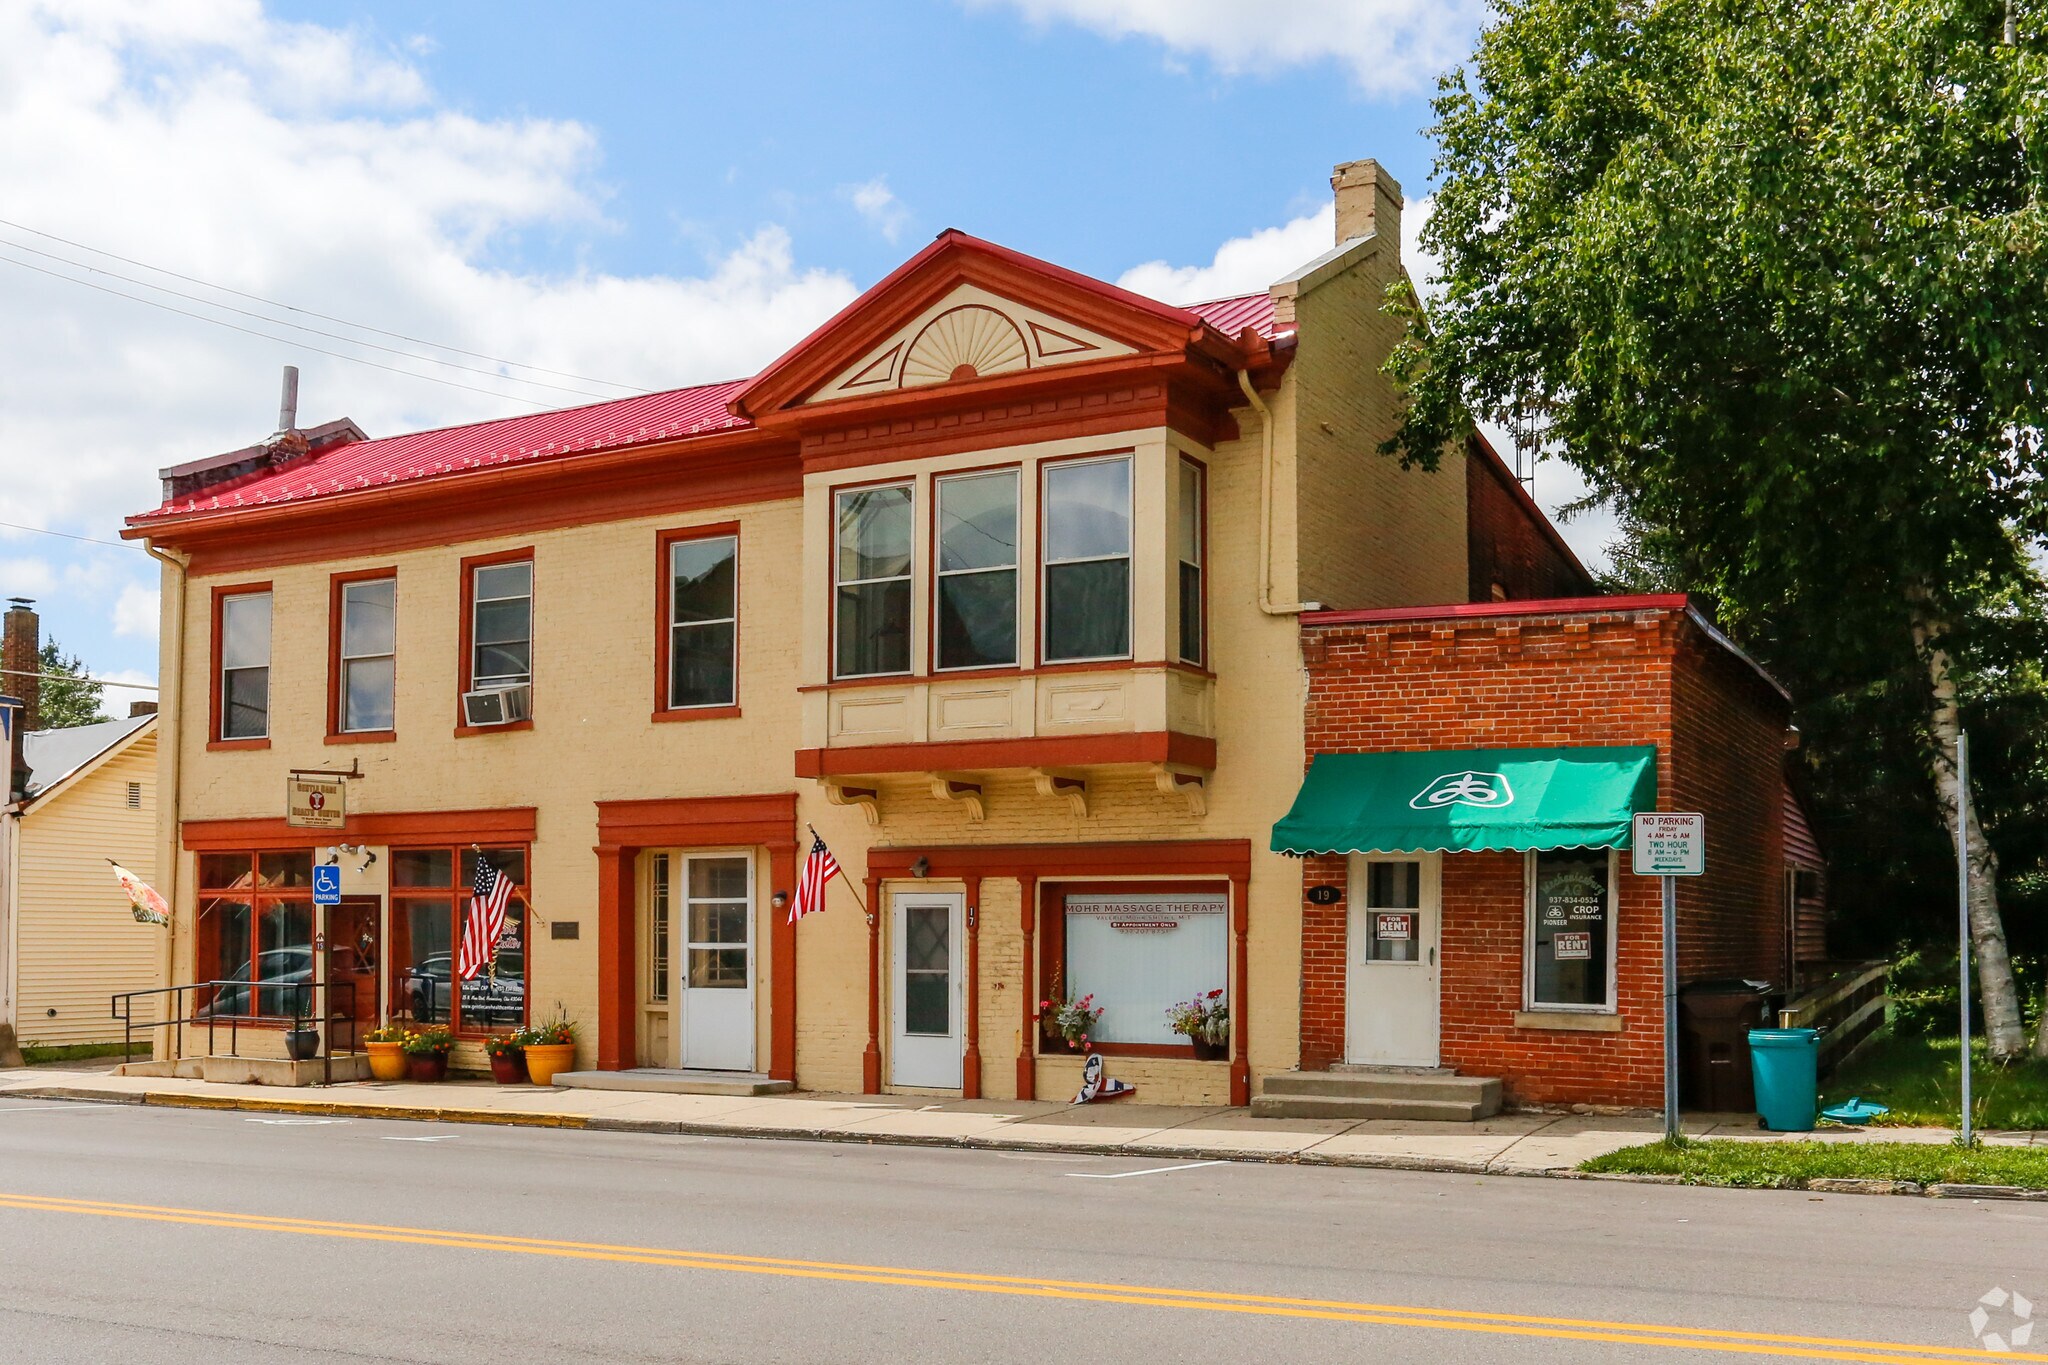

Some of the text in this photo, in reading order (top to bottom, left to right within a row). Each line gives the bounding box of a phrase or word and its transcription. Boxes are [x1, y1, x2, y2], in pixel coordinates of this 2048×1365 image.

[1643, 817, 1694, 825] NO PARKING
[1318, 889, 1330, 900] 19
[1066, 904, 1225, 913] MOHR MASSAGE THERAPY
[1573, 905, 1599, 914] CROP
[969, 907, 974, 926] 17
[1380, 921, 1407, 931] RENT
[1558, 940, 1587, 950] RENT
